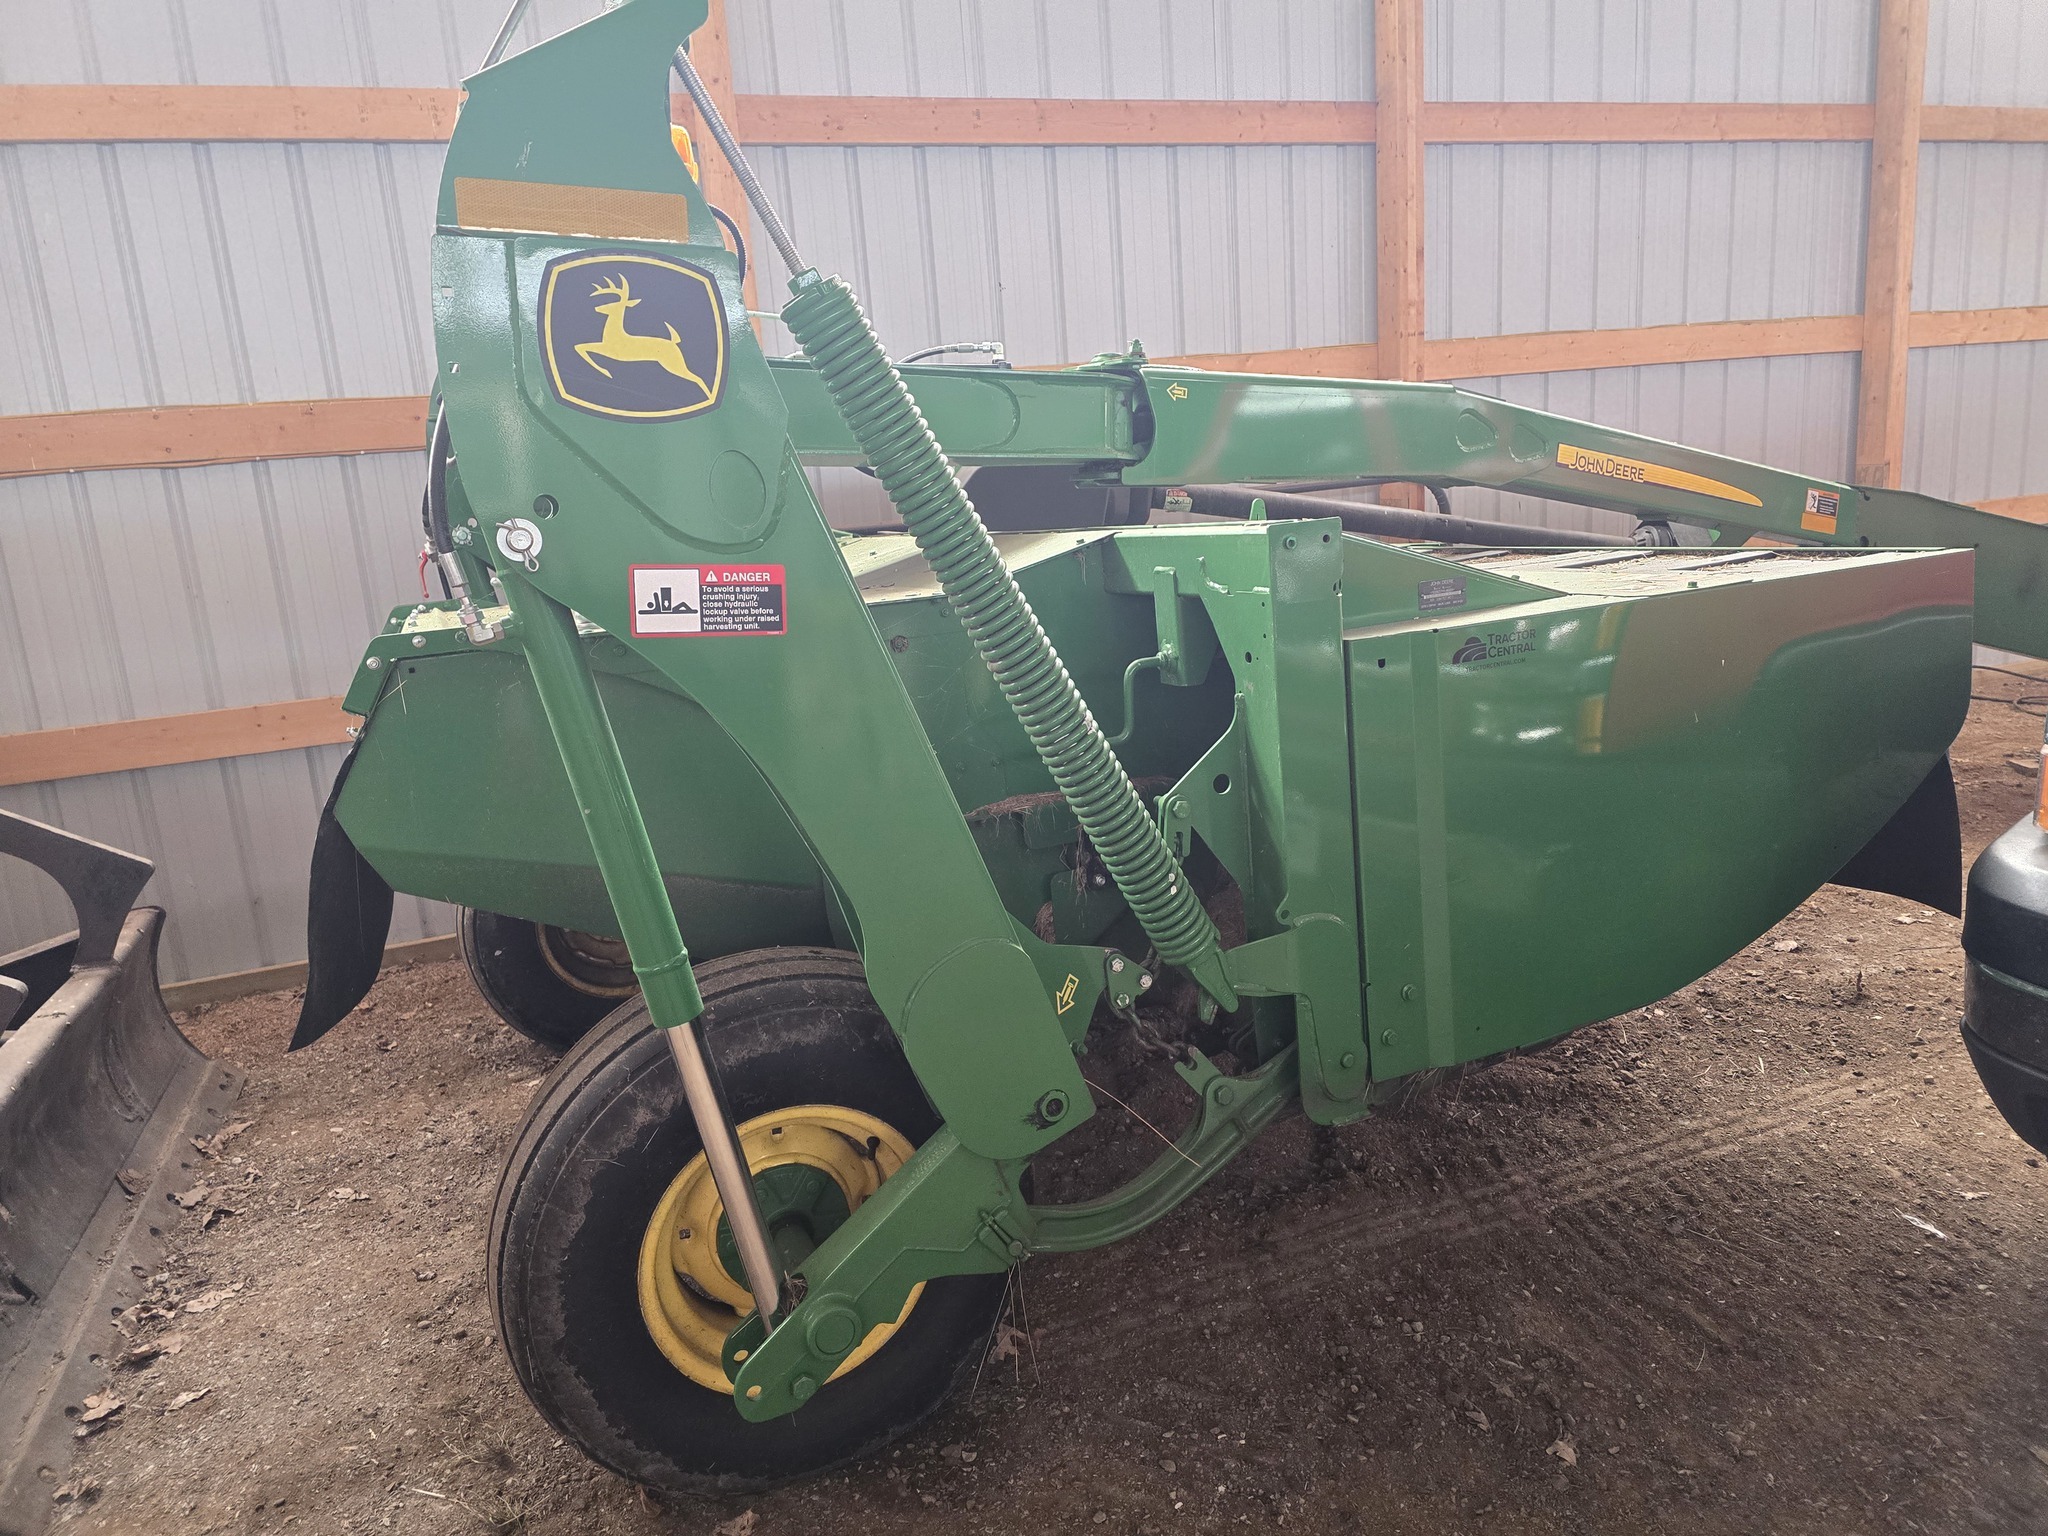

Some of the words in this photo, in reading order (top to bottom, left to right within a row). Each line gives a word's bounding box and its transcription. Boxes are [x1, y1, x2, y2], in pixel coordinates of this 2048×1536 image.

[1570, 451, 1604, 474] JOHN
[1605, 458, 1645, 482] DEERE
[723, 572, 771, 582] DANGER
[702, 593, 735, 601] crushing
[736, 593, 760, 601] injury,
[724, 600, 759, 608] hydraulic
[702, 608, 728, 616] lockup
[750, 607, 774, 615] before
[757, 614, 780, 622] raised
[703, 623, 743, 631] harvesting
[1487, 628, 1536, 645] TRACTOR
[1487, 642, 1536, 658] CENTRAL
[1466, 657, 1526, 672] TRACTORCENTRAL.COM
